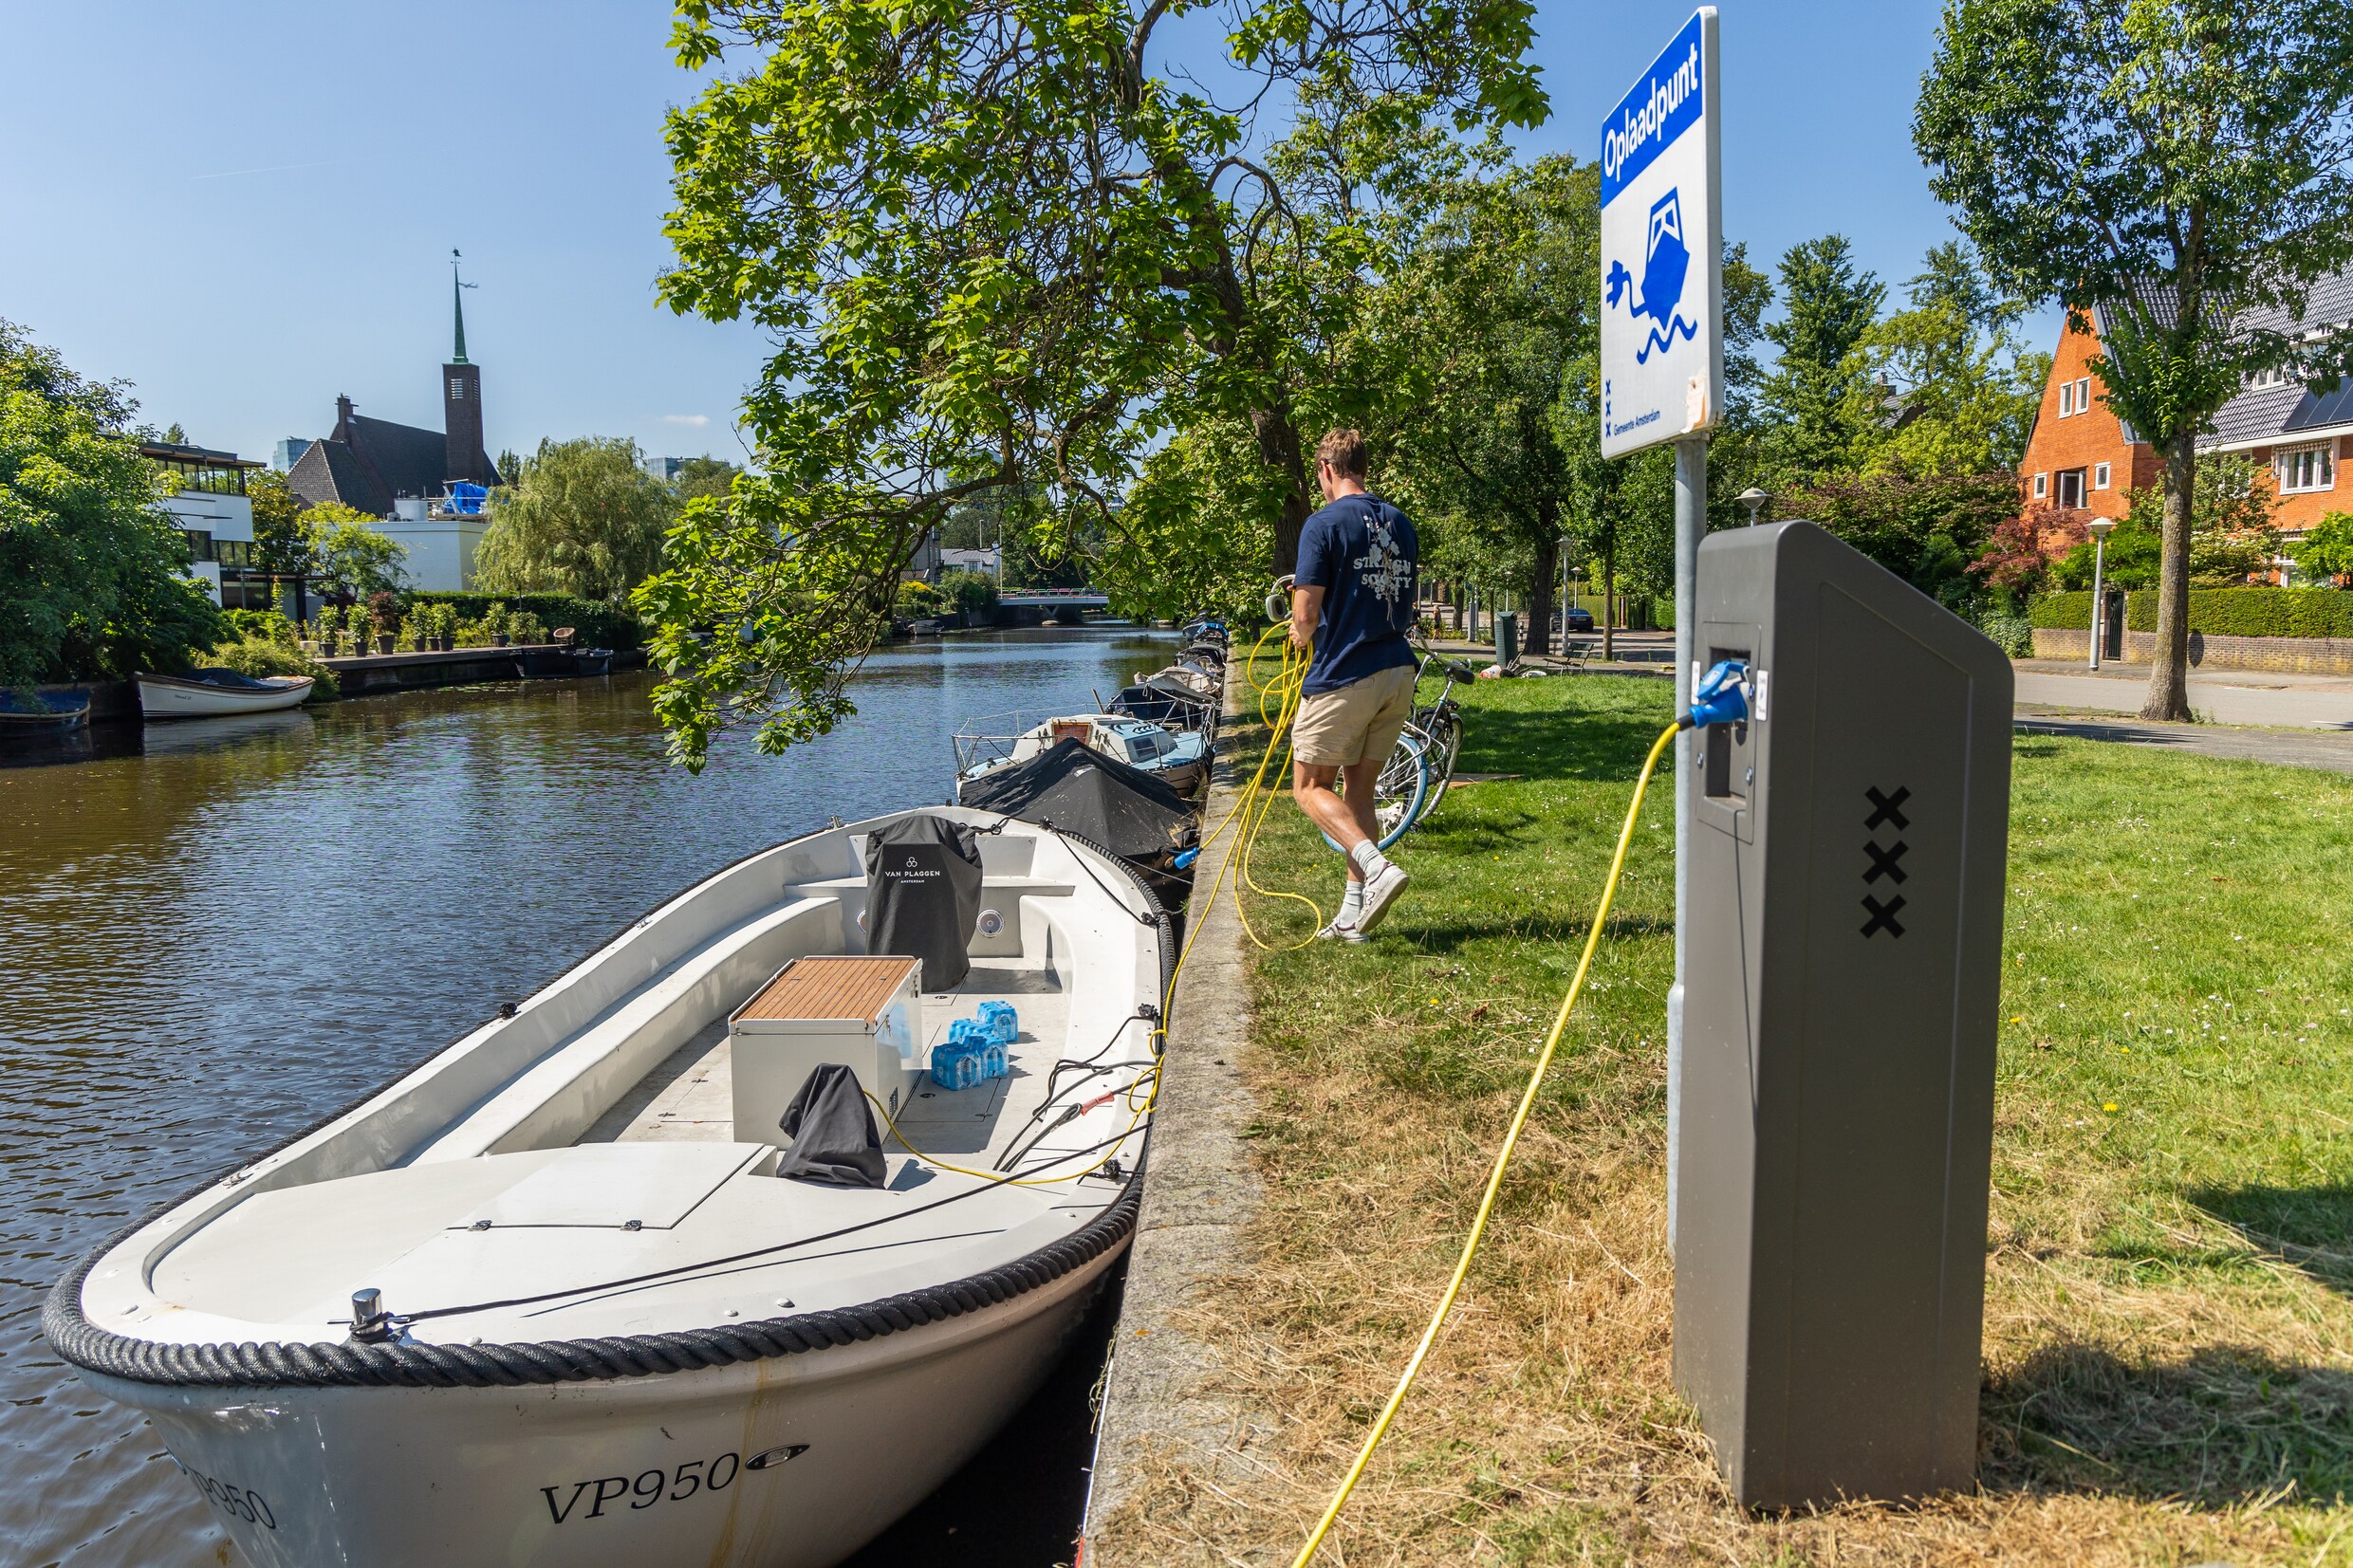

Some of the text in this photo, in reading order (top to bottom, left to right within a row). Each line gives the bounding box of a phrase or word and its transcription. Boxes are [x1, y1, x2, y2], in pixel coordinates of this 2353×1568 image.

[1603, 43, 1698, 182] Oplaadpunt
[1636, 409, 1660, 427] Amsterdam
[540, 1452, 740, 1524] VP950
